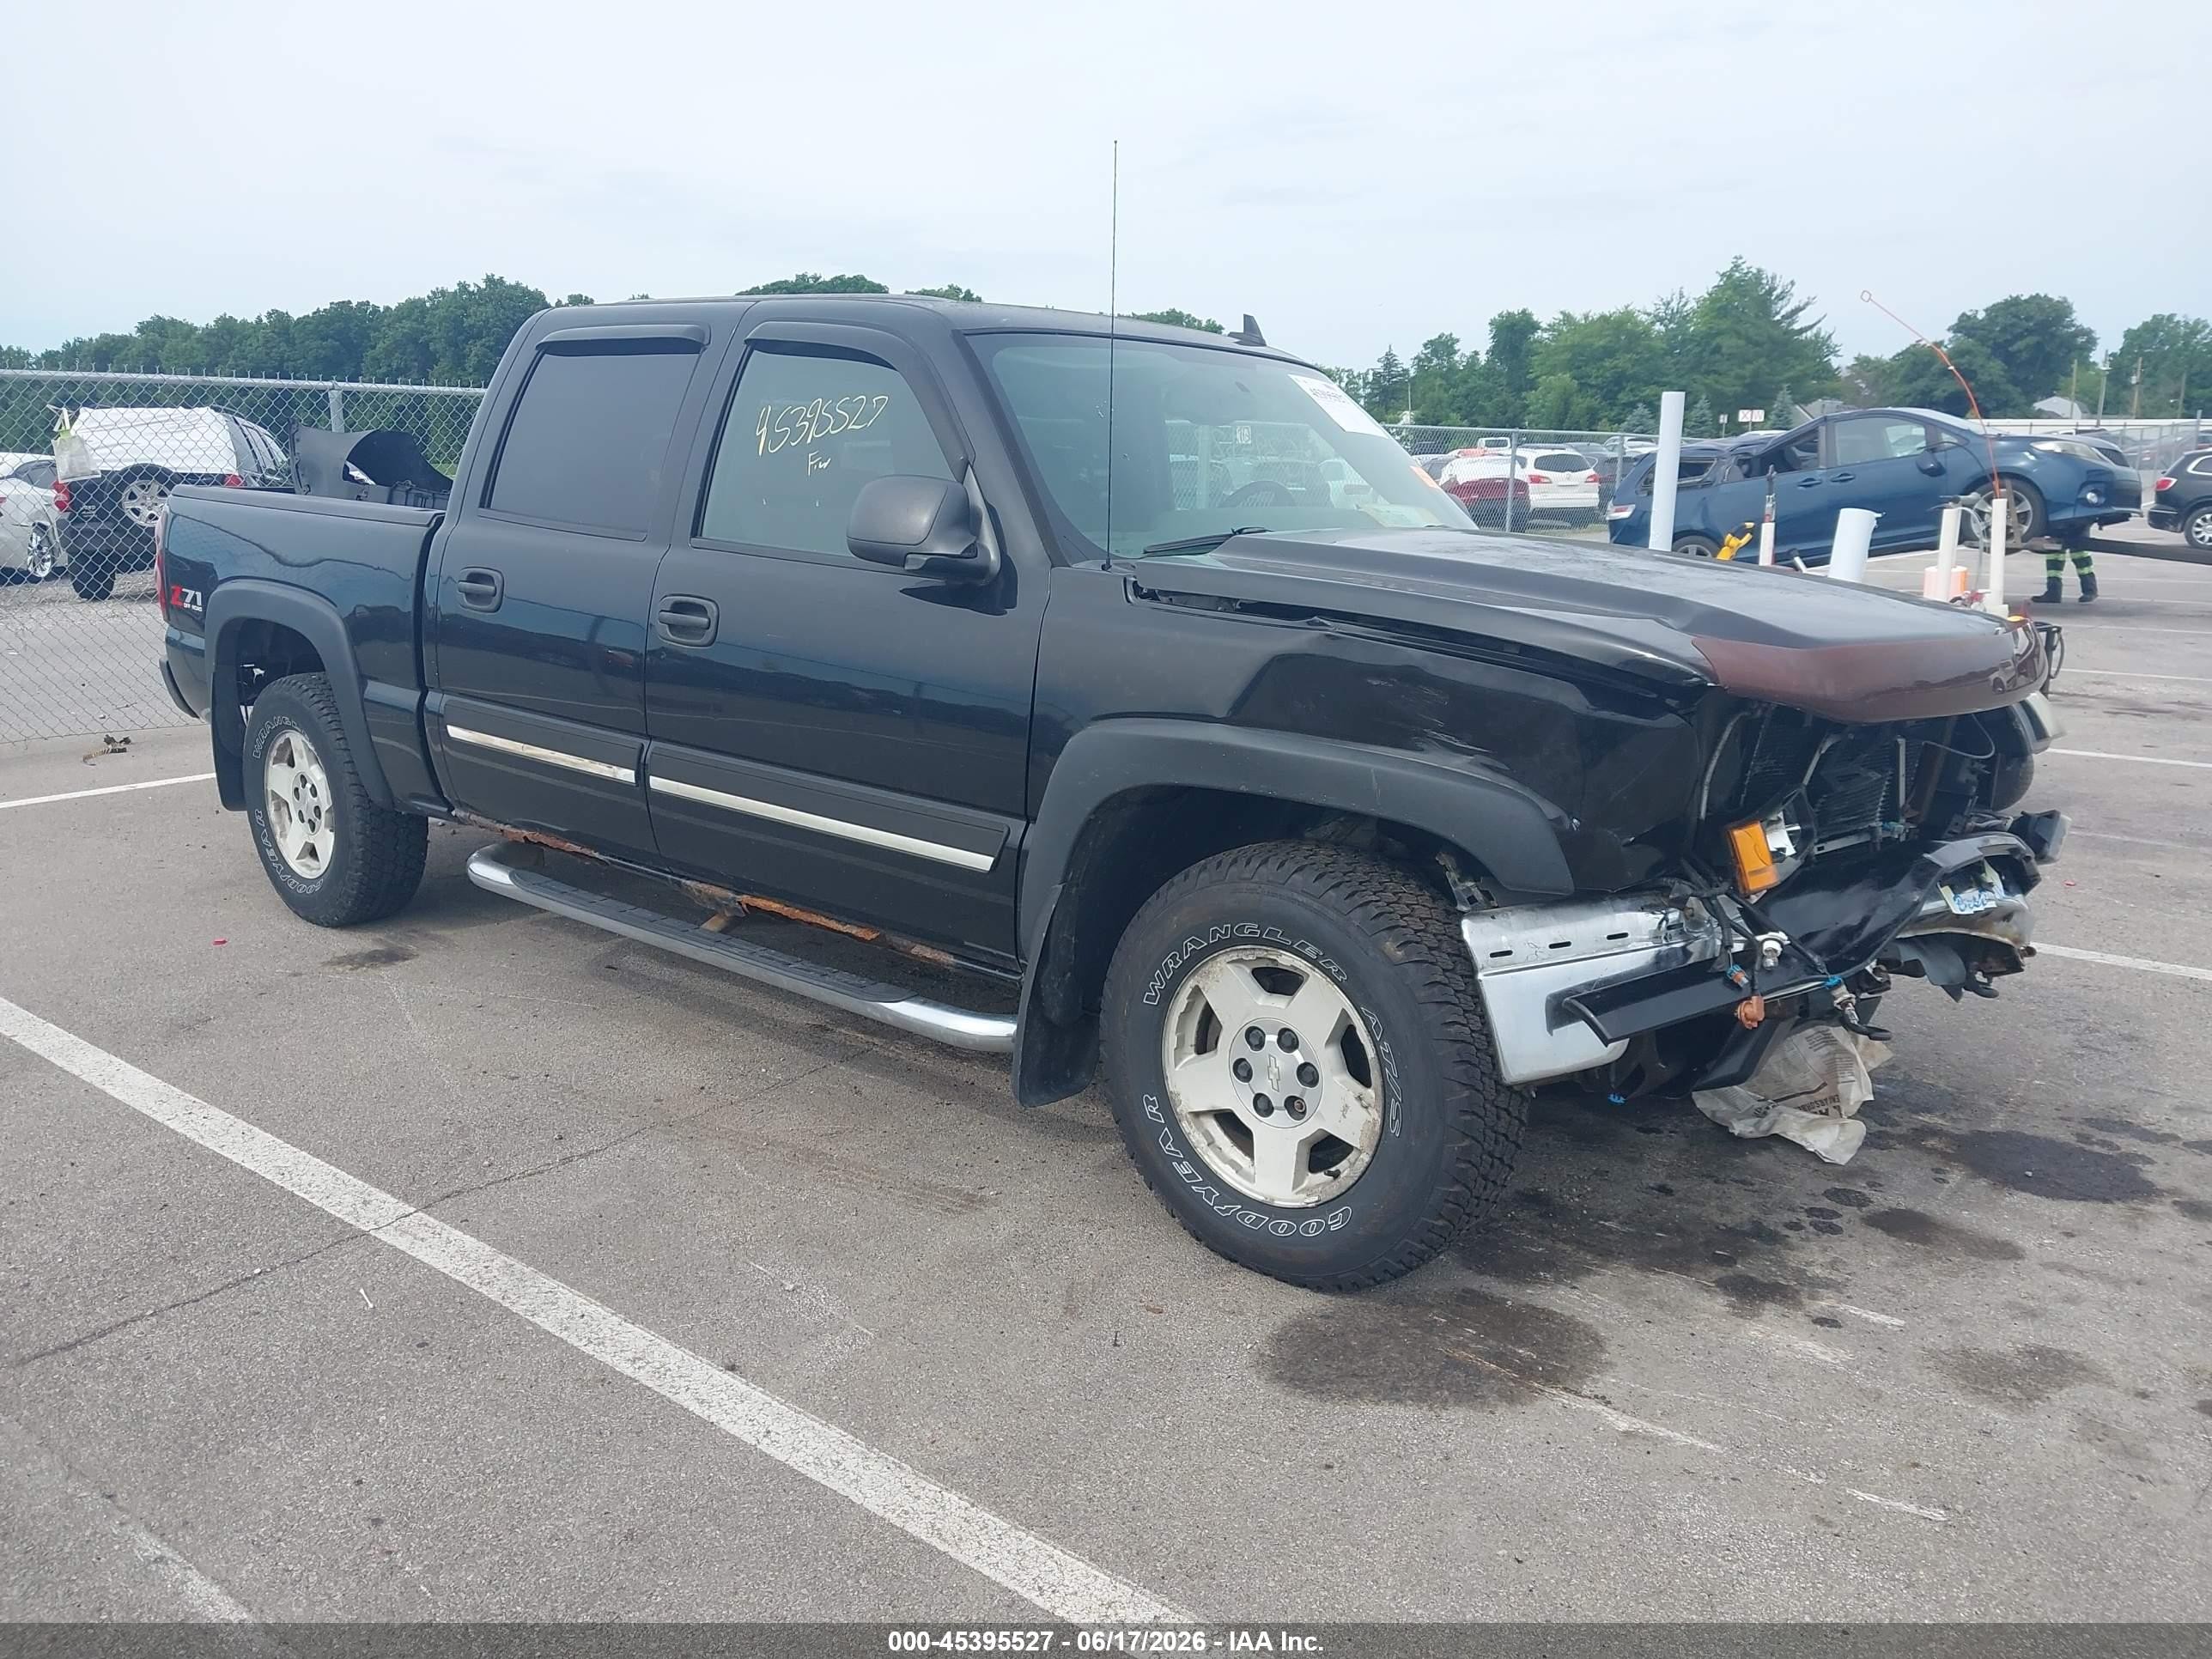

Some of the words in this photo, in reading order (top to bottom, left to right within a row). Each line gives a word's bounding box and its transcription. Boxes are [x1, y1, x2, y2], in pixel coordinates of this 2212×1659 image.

[756, 395, 889, 457] 45395527
[172, 586, 202, 606] Z71
[255, 809, 323, 894] GOODYEAR
[1143, 922, 1347, 1006] WRANGLER
[1142, 1094, 1352, 1237] GOODYEAR
